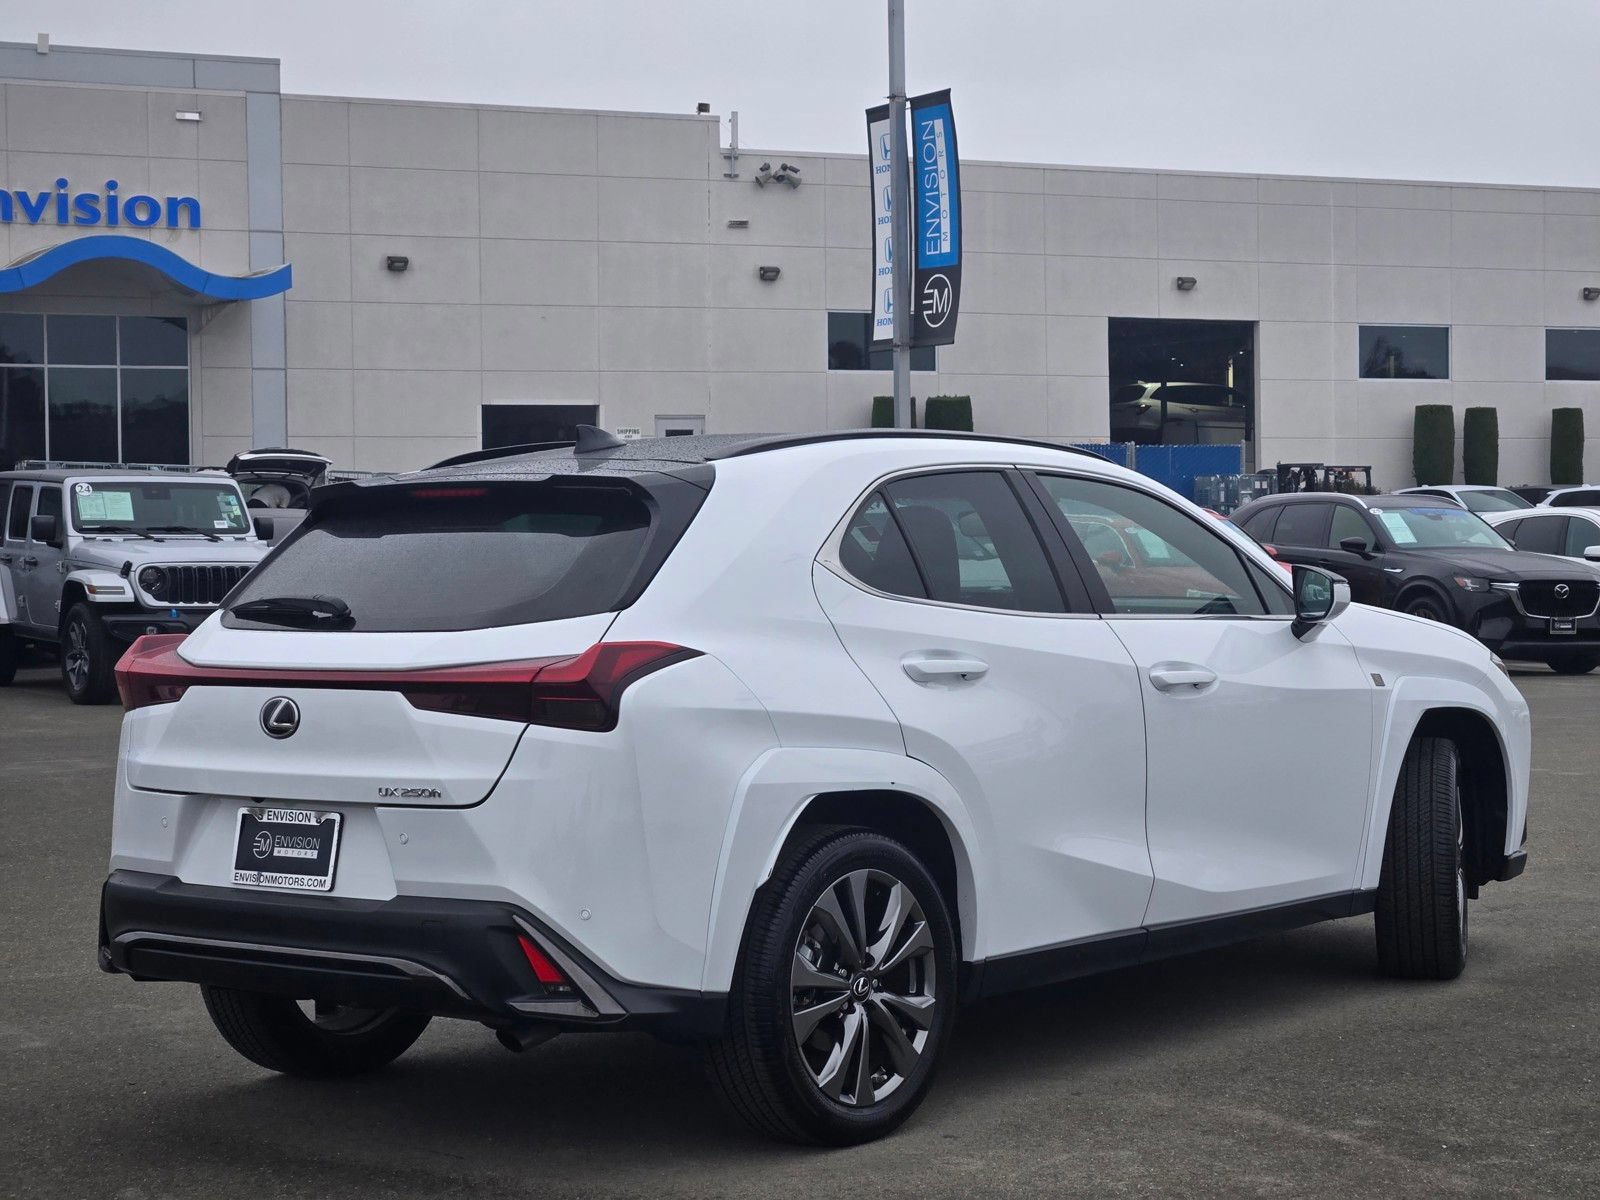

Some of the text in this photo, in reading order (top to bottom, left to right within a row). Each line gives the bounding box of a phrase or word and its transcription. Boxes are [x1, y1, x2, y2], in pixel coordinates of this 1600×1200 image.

[921, 120, 940, 255] ENVISION
[937, 131, 948, 241] MOTORS
[77, 484, 91, 493] 24
[378, 787, 441, 798] UX 250h
[266, 809, 312, 824] ENVISION
[274, 835, 321, 850] ENVISION
[277, 849, 315, 857] MOTORS
[234, 872, 327, 889] ENVISIONMOTORS.COM
